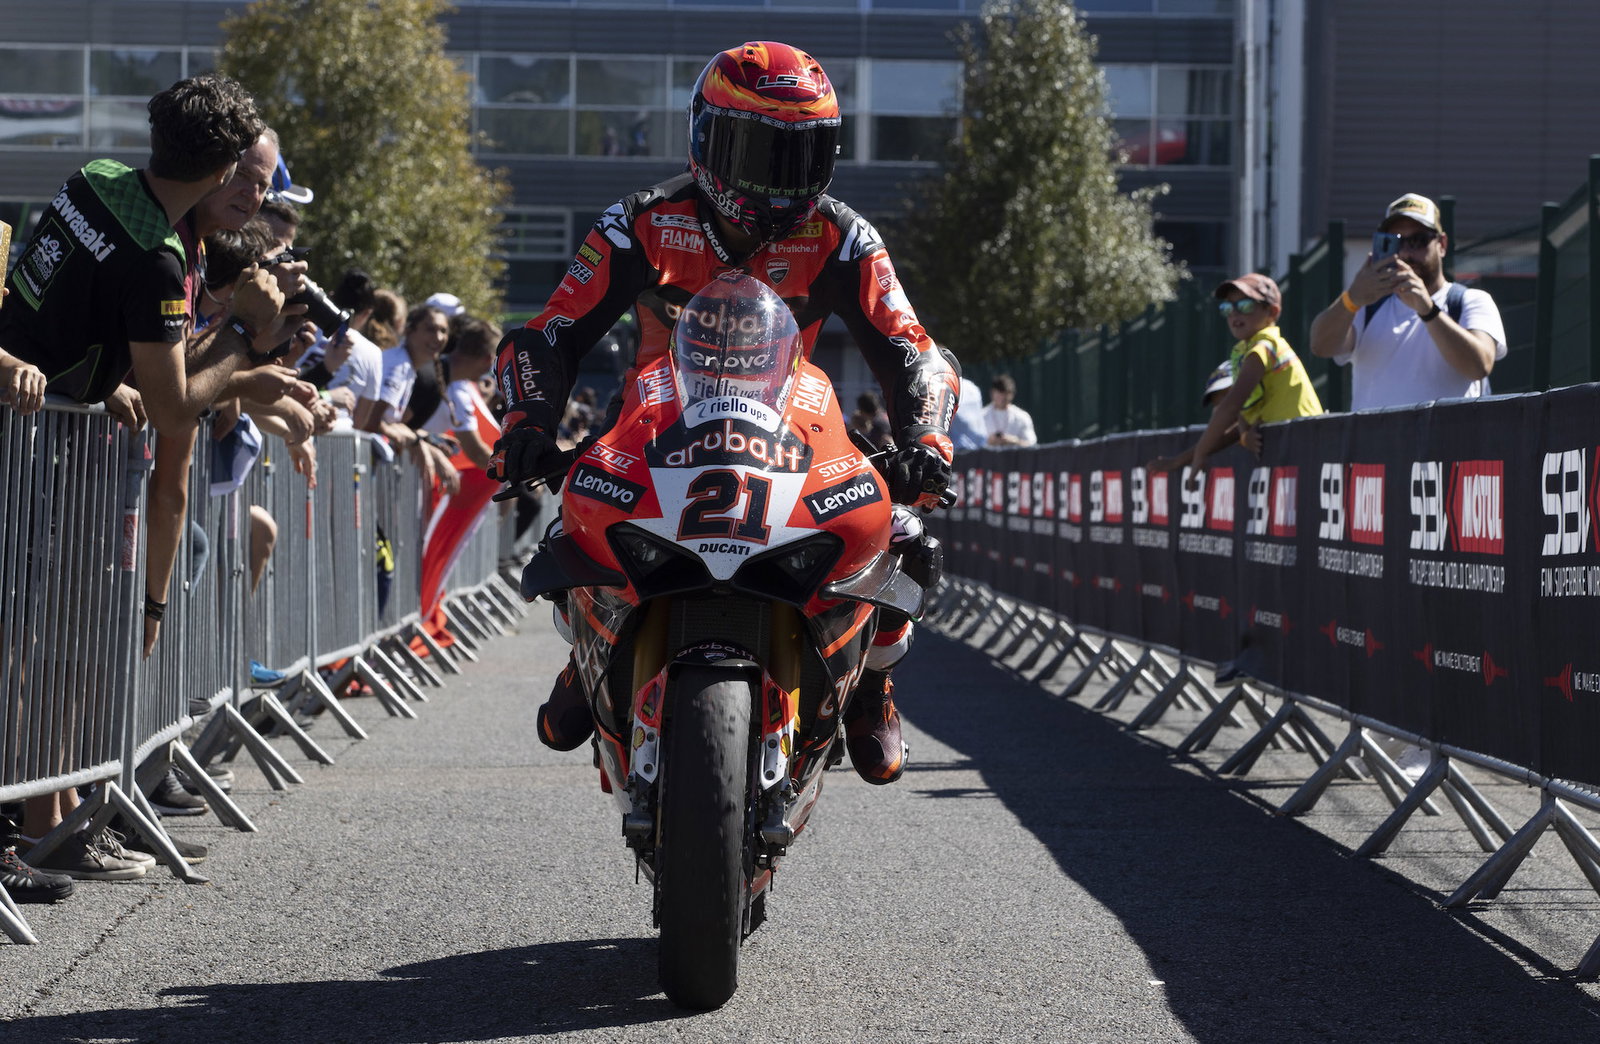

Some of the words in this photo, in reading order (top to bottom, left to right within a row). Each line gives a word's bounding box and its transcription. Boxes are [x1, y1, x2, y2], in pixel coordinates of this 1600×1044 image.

[756, 75, 817, 94] LS2
[660, 229, 705, 252] FIAMM
[702, 222, 729, 262] DUCATI
[710, 398, 748, 414] riello
[750, 407, 768, 422] ups
[792, 371, 827, 415] FIAMM
[663, 418, 805, 473] aruba.it
[574, 468, 635, 504] Lenovo
[811, 481, 876, 516] Lenovo
[676, 468, 774, 547] 21
[1462, 474, 1503, 541] MOTUL
[698, 543, 751, 556] DUCATI
[1541, 566, 1553, 598] FIM
